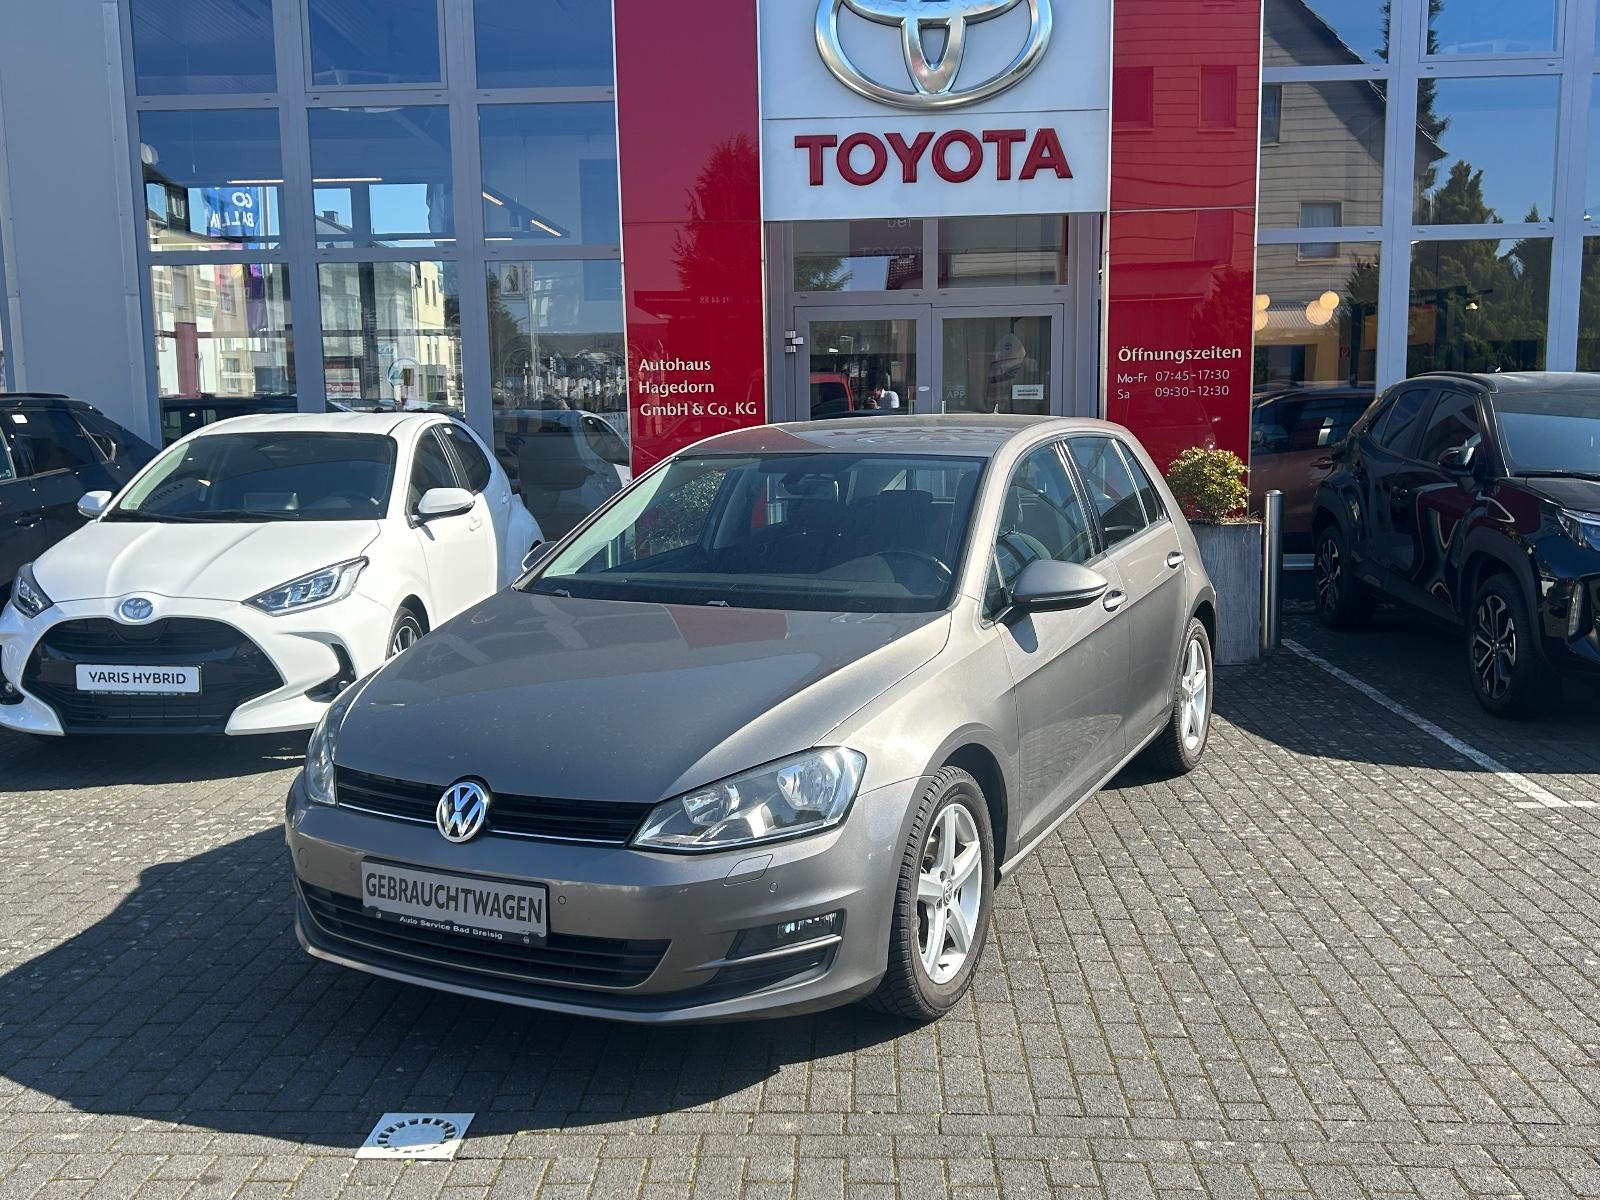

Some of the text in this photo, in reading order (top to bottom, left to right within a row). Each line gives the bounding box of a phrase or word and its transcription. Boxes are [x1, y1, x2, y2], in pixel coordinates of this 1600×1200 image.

[795, 128, 1073, 186] TOYOTA
[1118, 346, 1242, 364] Öffnungszeiten
[639, 357, 711, 371] Autohaus
[1117, 369, 1230, 384] Mo-Fr 07:45-17:30
[639, 380, 715, 398] Hagedorn
[1117, 385, 1230, 400] Sa 09:30-12:30
[640, 402, 689, 416] GmbH
[692, 402, 705, 416] &
[707, 402, 732, 415] Co.
[735, 401, 757, 415] KG
[88, 671, 187, 685] YARIS HYBRID
[365, 872, 543, 924] GEBRAUCHTWAGEN
[399, 915, 418, 925] Auto
[420, 919, 451, 931] Service
[453, 924, 470, 934] Bad
